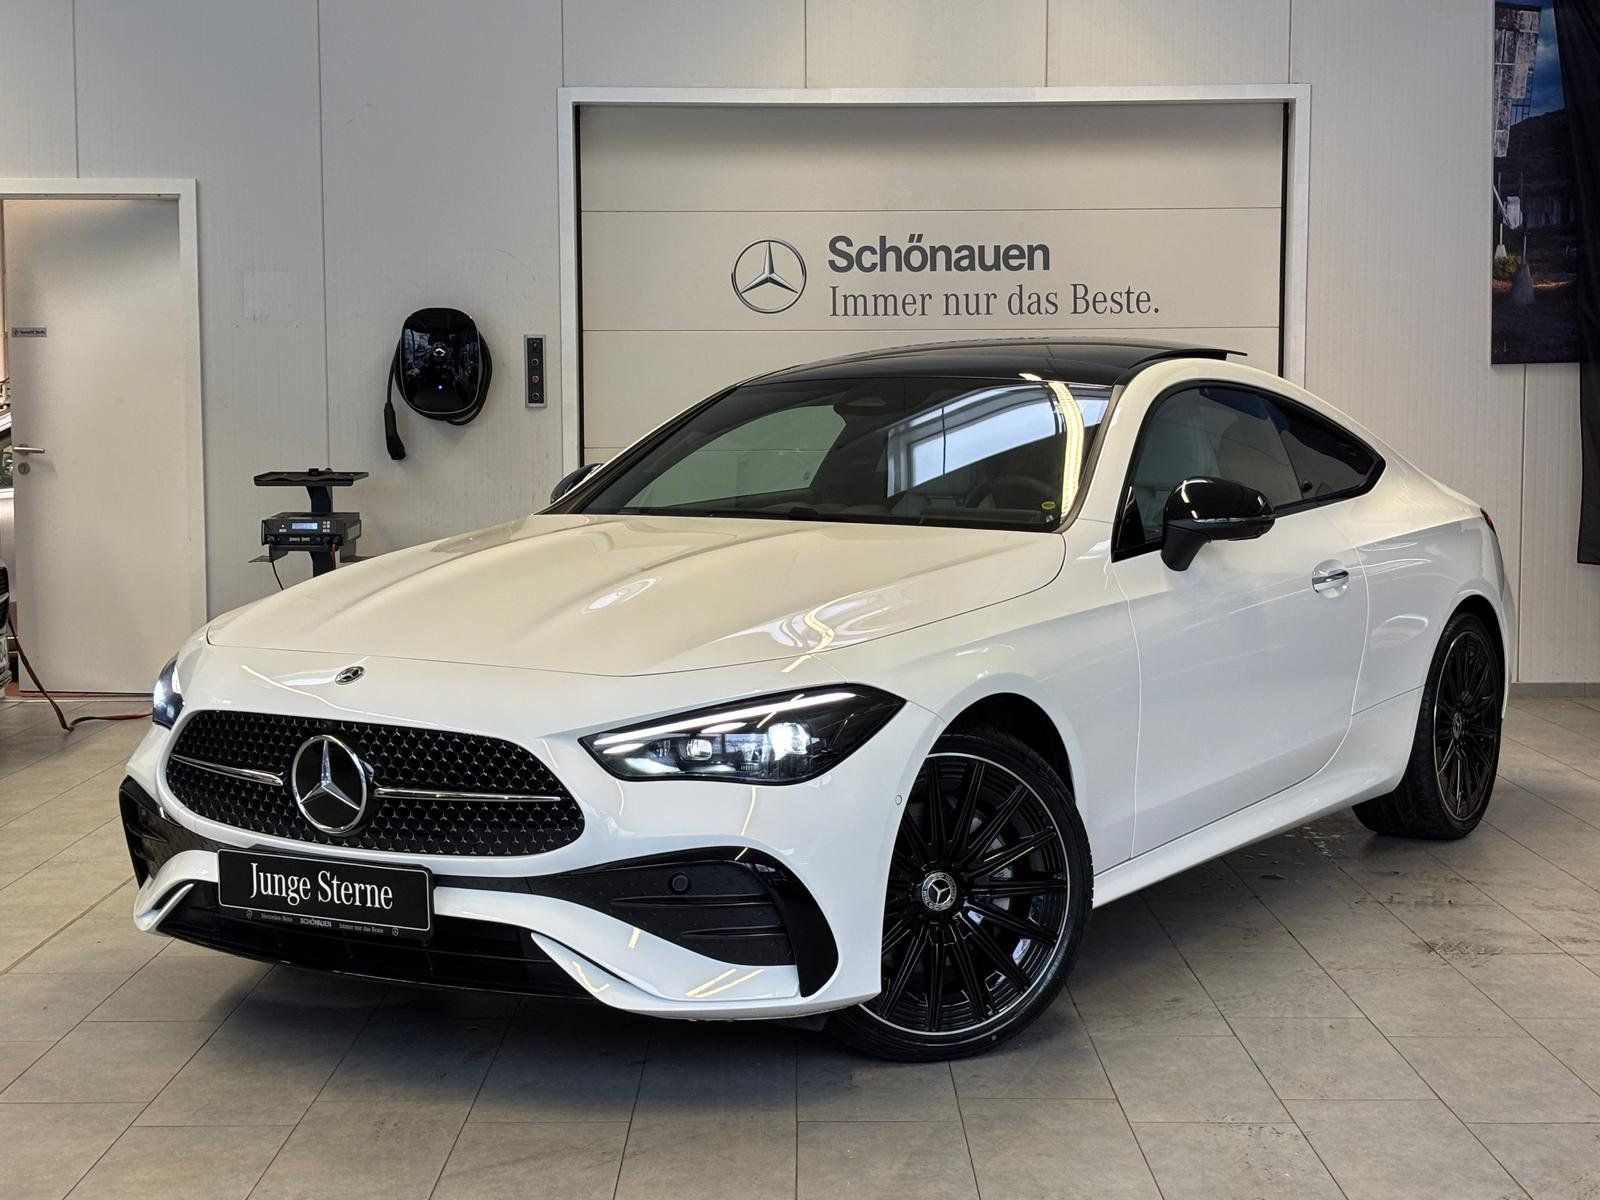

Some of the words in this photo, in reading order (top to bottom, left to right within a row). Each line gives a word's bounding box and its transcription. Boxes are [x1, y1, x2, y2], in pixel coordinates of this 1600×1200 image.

[829, 286, 933, 317] Immer
[943, 292, 998, 316] nur
[1007, 284, 1059, 316] das
[1070, 283, 1160, 315] Beste.
[249, 862, 311, 906] Junge
[317, 870, 394, 910] Sterne
